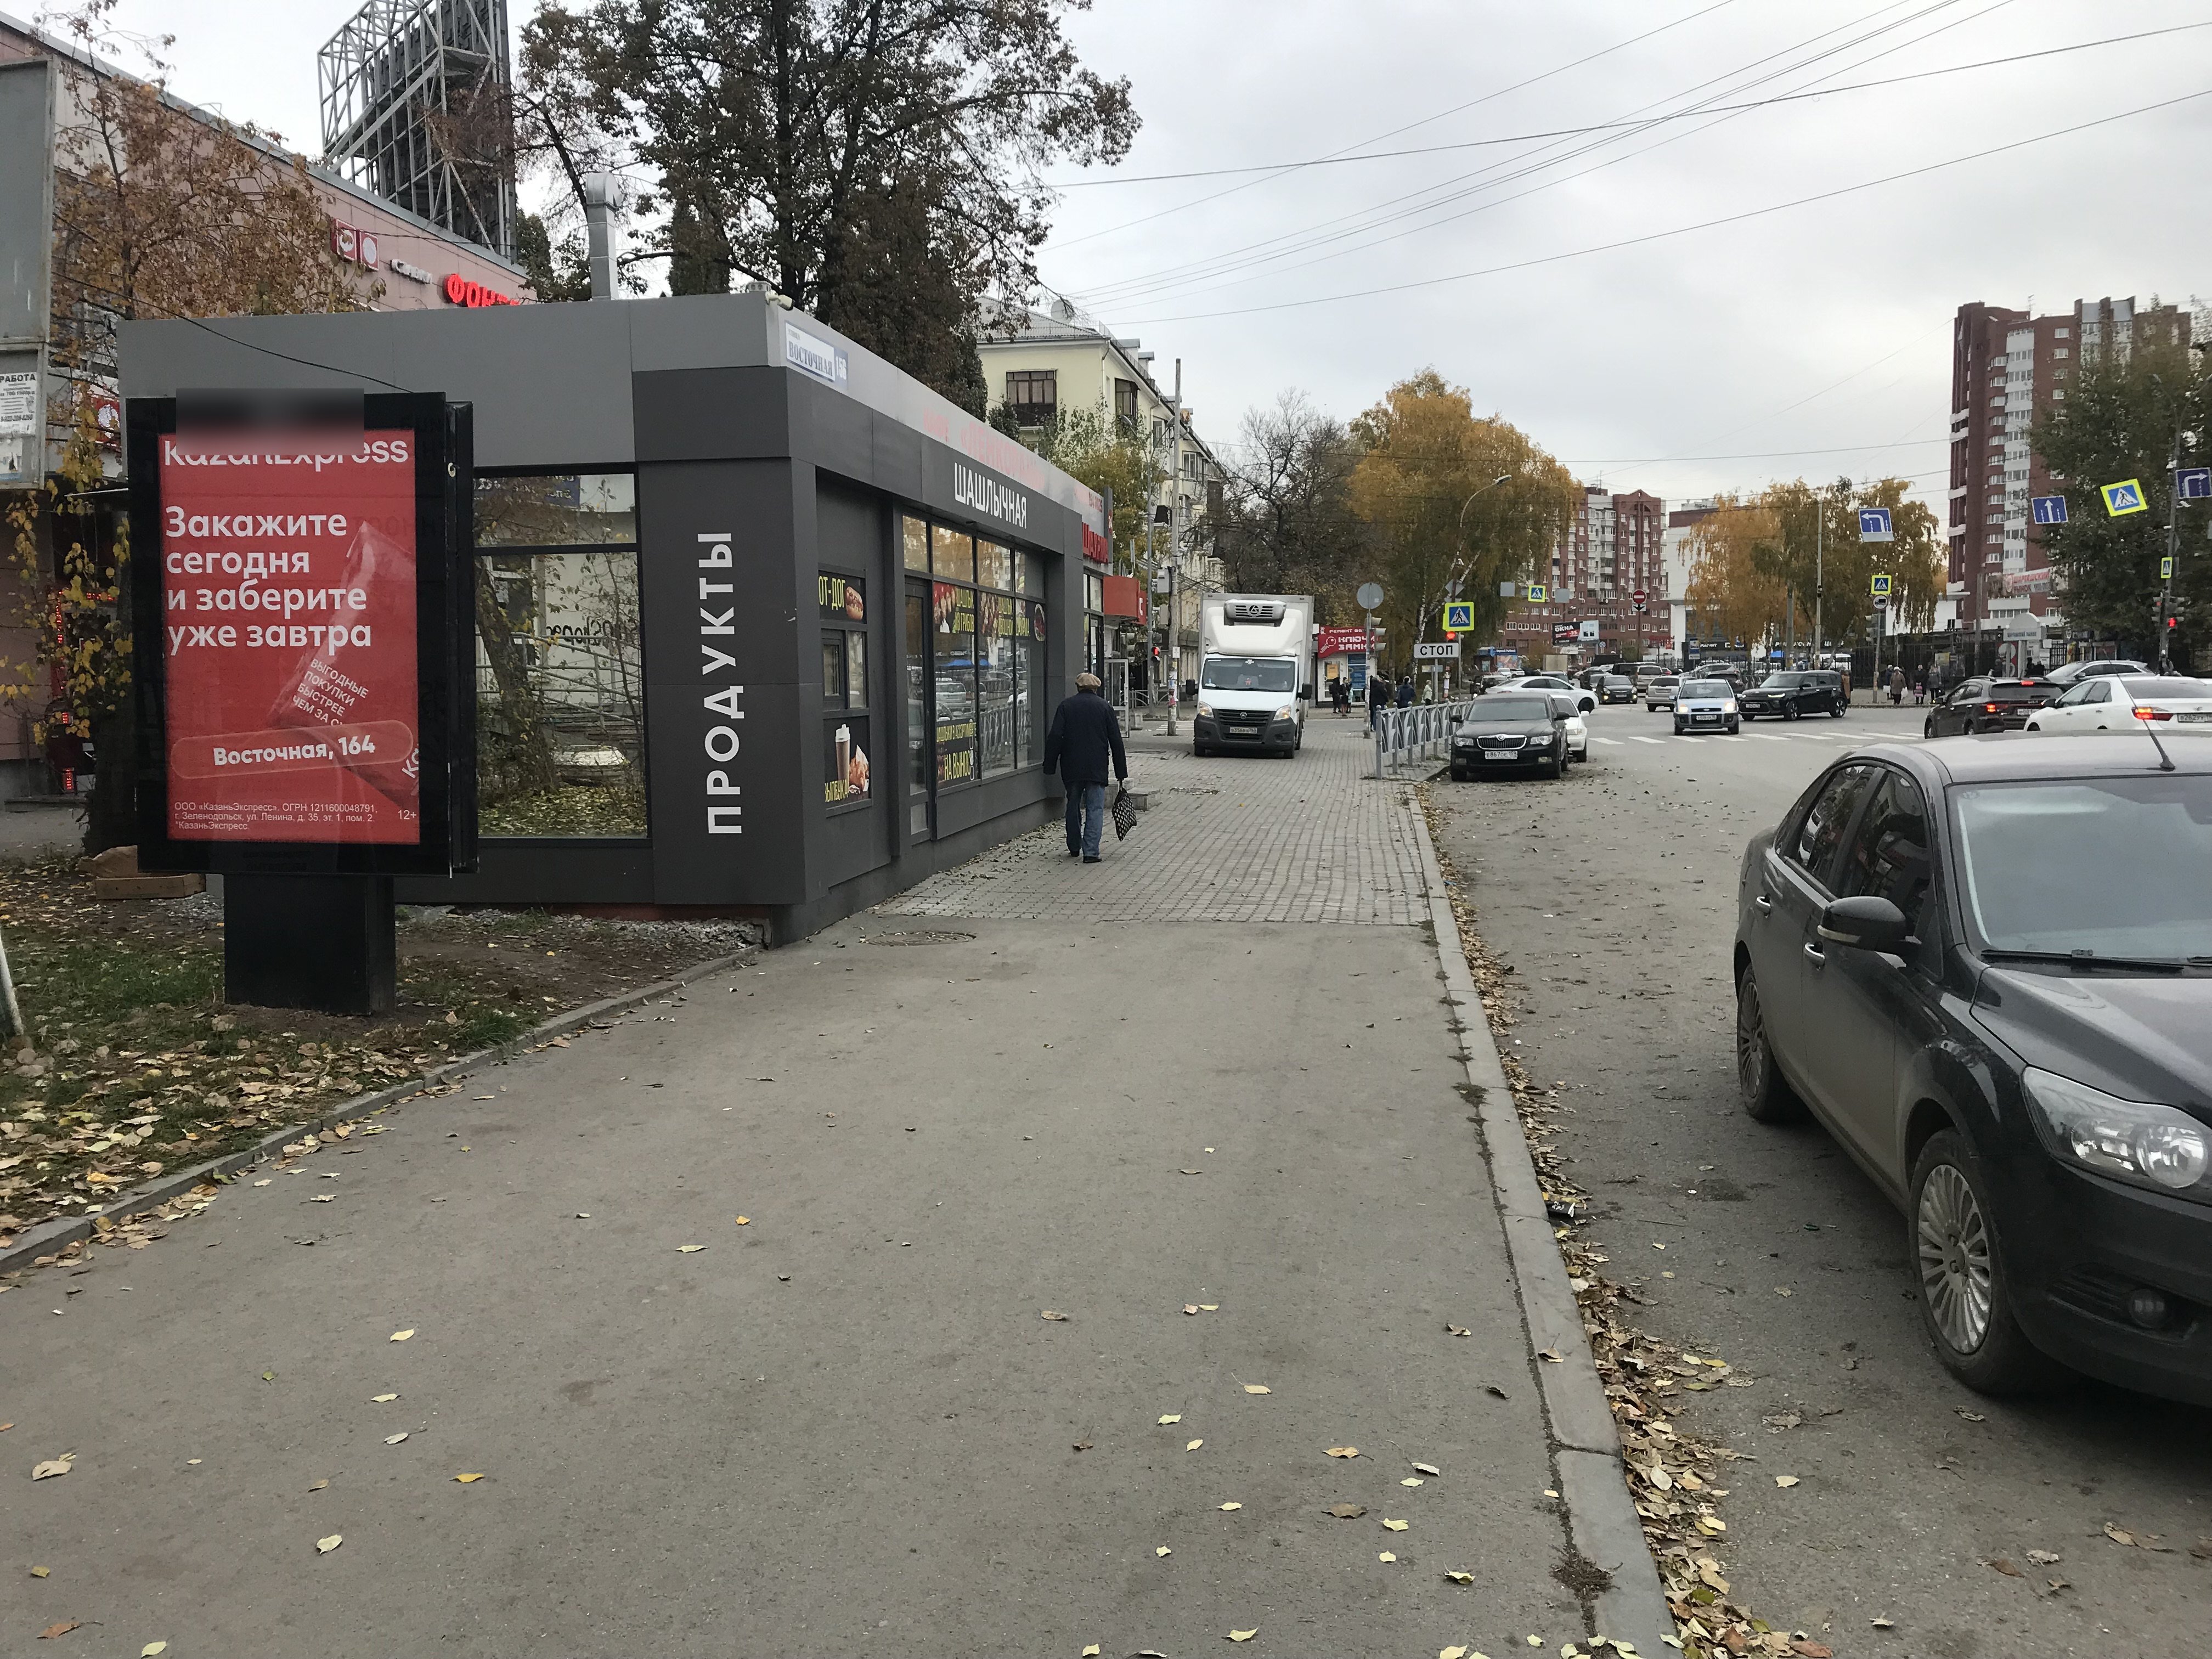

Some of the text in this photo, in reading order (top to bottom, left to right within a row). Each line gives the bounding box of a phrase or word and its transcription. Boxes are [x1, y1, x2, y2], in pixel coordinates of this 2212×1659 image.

[788, 340, 833, 377] ВОСТОЧНАЯ
[0, 374, 36, 383] РАБОТА
[955, 462, 1027, 529] ШАШЛЫЧНАЯ
[166, 506, 347, 537] Закажите
[166, 551, 309, 579] сегодня
[167, 578, 367, 619] и заберите
[819, 575, 845, 611] ОТ-ДОГ
[167, 624, 371, 656] уже завтра
[1420, 645, 1453, 656] СТОП
[304, 670, 356, 707] ПОКУПКИ
[311, 658, 369, 699] ВЫГОДНЫЕ
[697, 533, 744, 834] ПРОДУКТЫ
[292, 695, 315, 714] ЧЕМ
[314, 709, 329, 724] ЗА
[297, 683, 346, 716] БЫСТРЕЕ
[213, 735, 376, 766] Восточная, 164
[174, 802, 377, 813] ООО «КазаньЭкспресс». ОГРН 1211600048791,
[182, 812, 244, 821] Зеленодольск,
[261, 812, 295, 822] Ленина,
[398, 809, 417, 820] 12+
